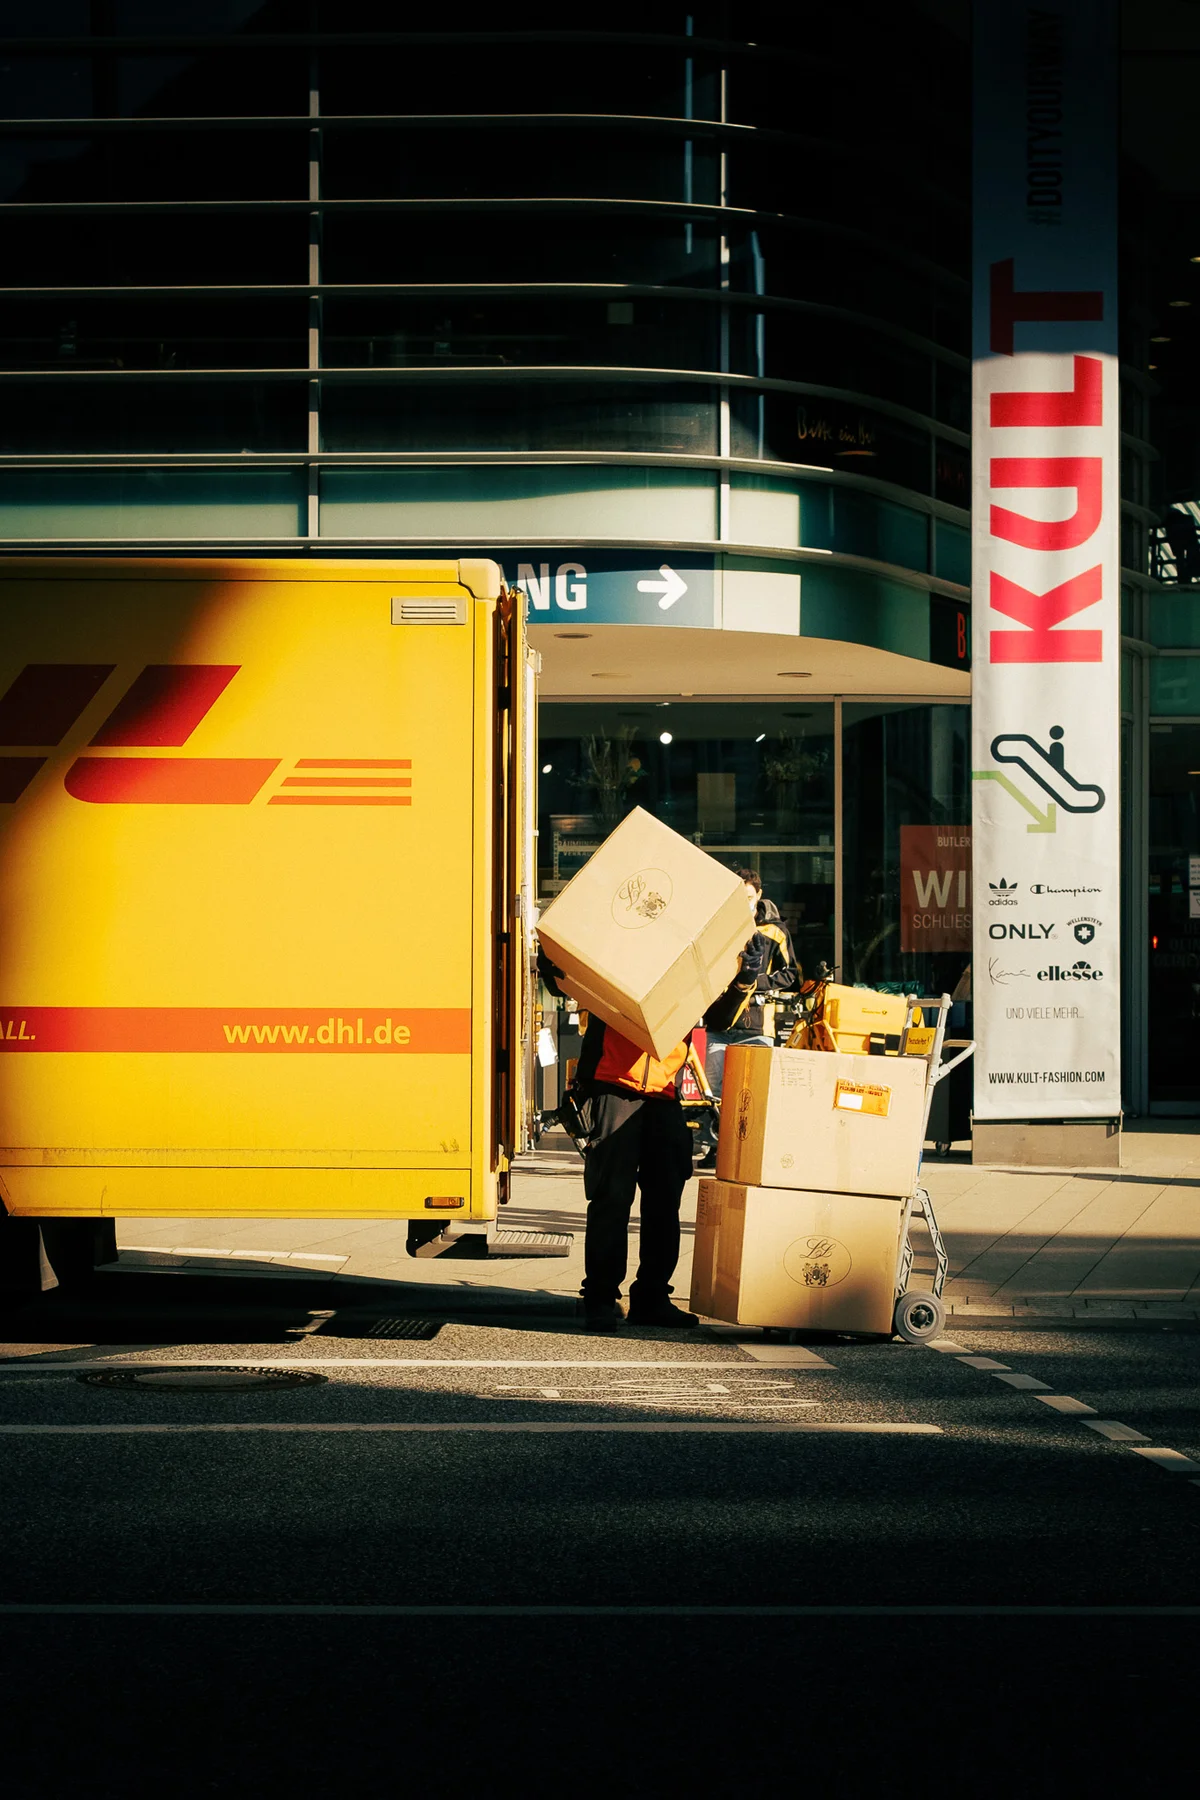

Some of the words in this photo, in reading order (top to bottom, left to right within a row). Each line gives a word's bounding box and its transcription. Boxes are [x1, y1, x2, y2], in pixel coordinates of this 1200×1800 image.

[1026, 6, 1064, 227] #DOITYOURWAY
[989, 257, 1104, 664] KULT
[498, 562, 588, 611] NG
[911, 870, 972, 908] WI
[1029, 883, 1102, 897] Champion
[988, 898, 1018, 906] adidas
[1036, 965, 1104, 981] ellesse
[1006, 1007, 1024, 1020] UND
[1027, 1007, 1051, 1020] VIELE
[223, 1017, 411, 1046] www.dhl.de
[988, 1071, 1105, 1084] WWW.KULT-FASHION.COM
